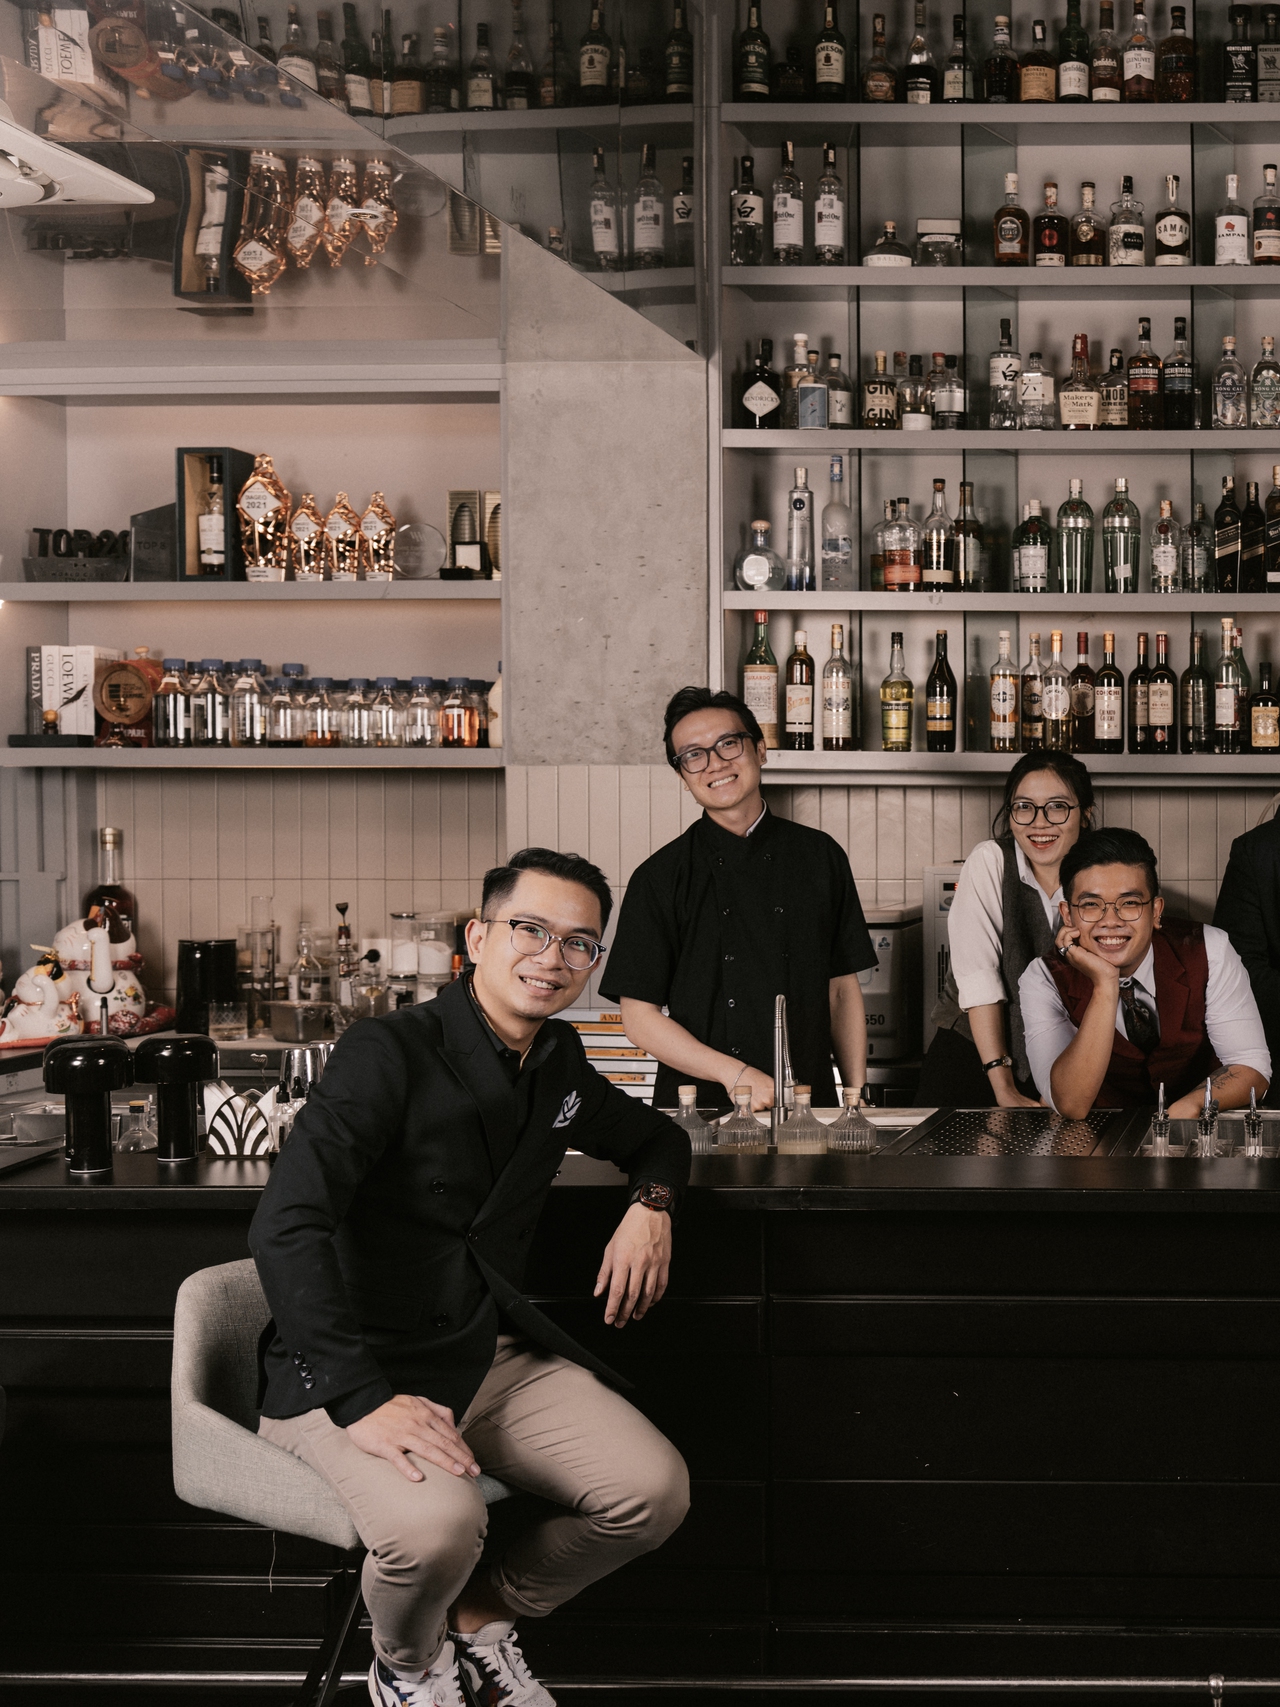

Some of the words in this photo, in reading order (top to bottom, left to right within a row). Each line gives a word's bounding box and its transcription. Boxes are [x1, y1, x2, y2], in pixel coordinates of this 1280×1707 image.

[737, 199, 756, 218] 白
[1157, 223, 1188, 235] SAMAI
[1001, 363, 1019, 381] 白
[867, 384, 895, 397] GIN
[1100, 388, 1126, 401] KNOB
[1072, 400, 1094, 408] Mark
[867, 408, 895, 420] GIN
[246, 501, 268, 509] 2021
[31, 652, 42, 699] PRADA
[46, 653, 55, 687] GUCCI
